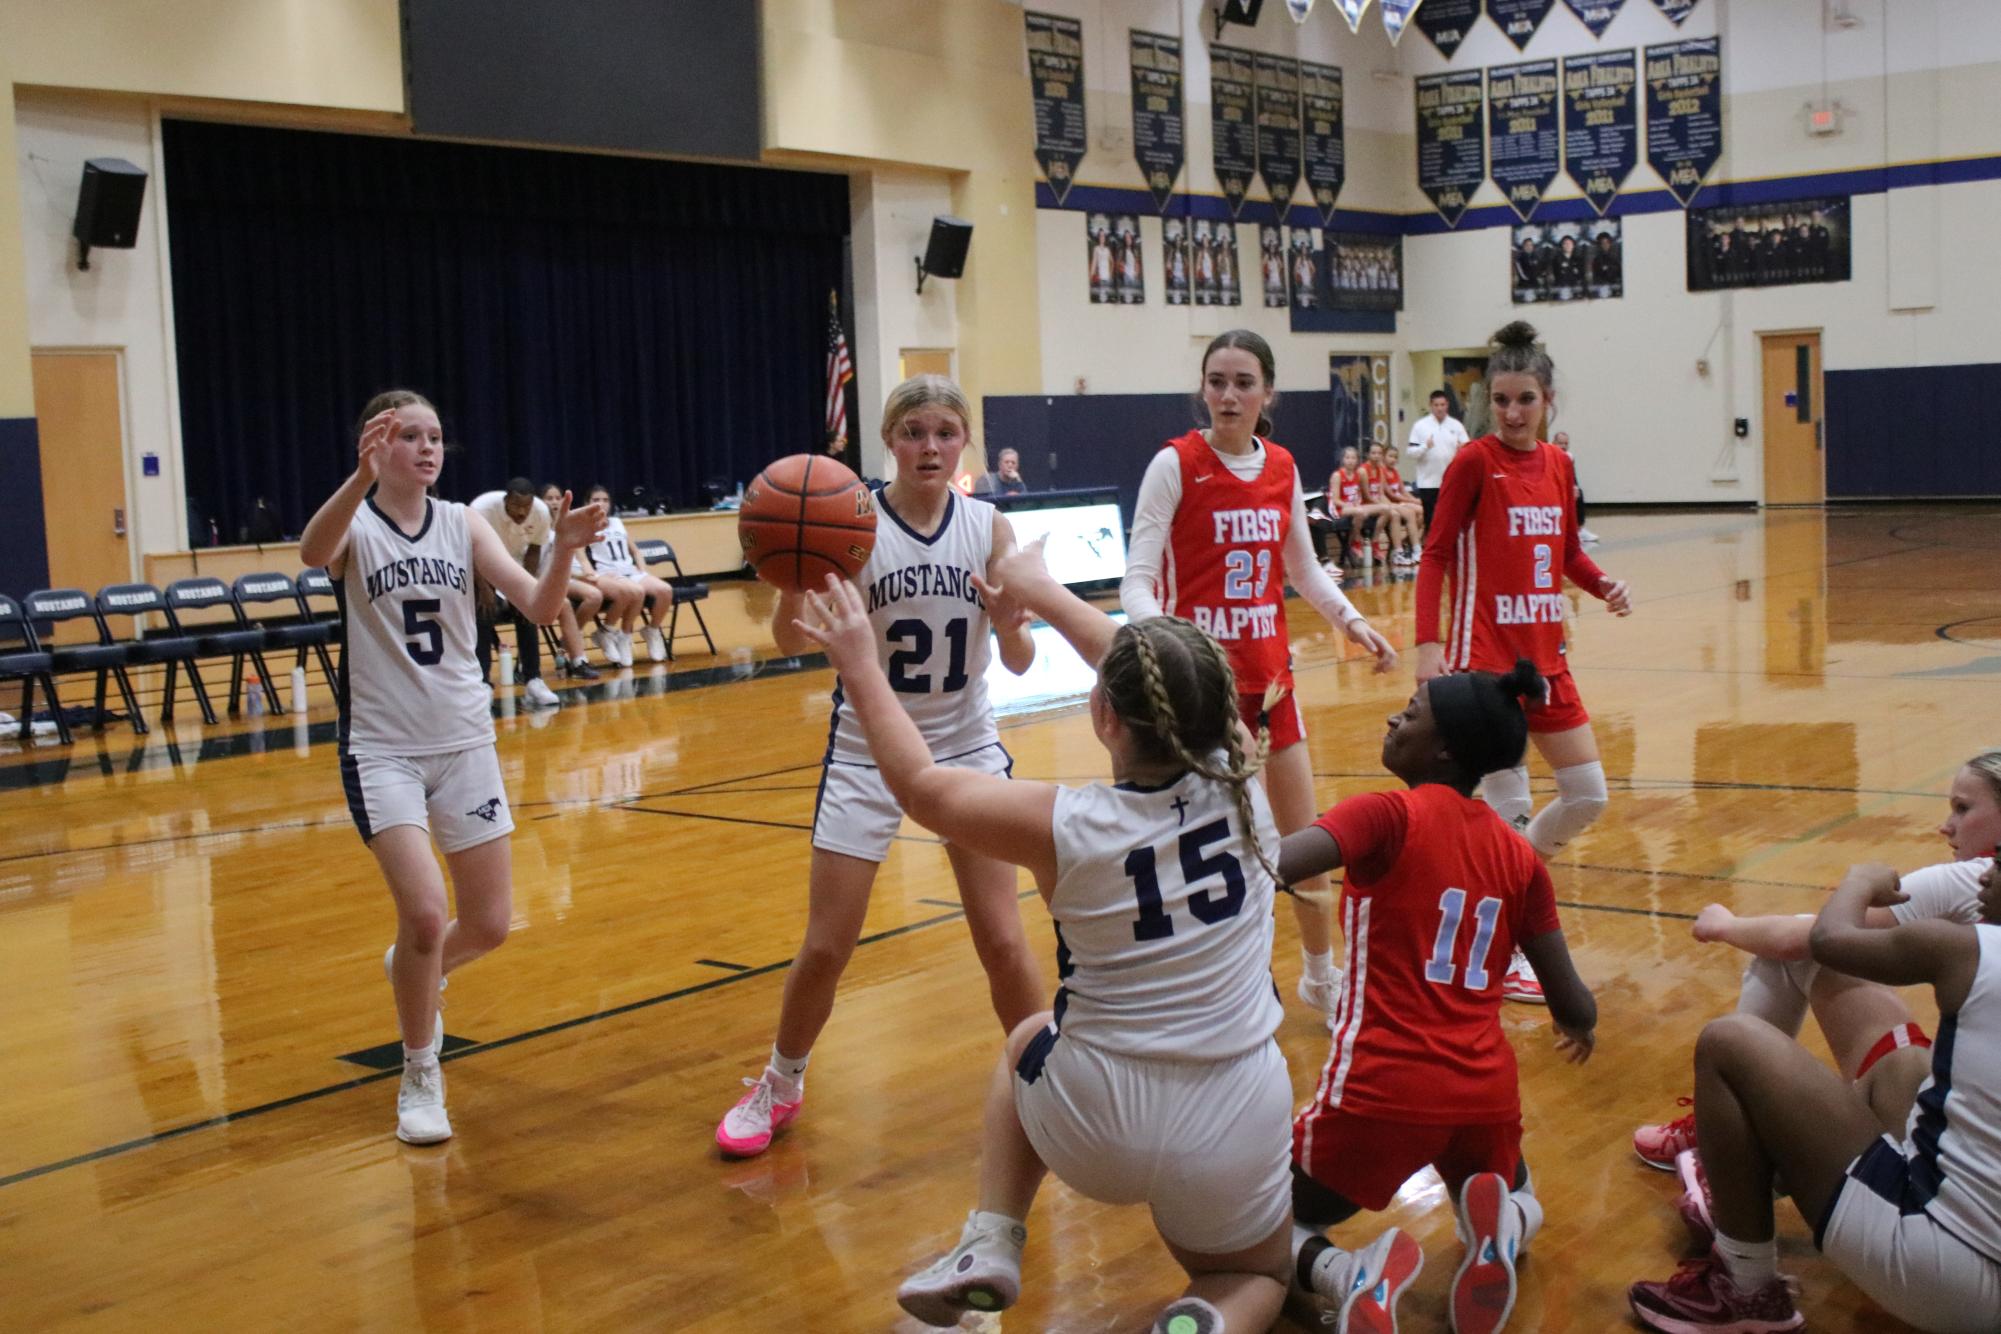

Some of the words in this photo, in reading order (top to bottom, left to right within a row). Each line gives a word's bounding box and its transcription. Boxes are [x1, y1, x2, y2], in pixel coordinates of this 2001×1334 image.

[1212, 509, 1281, 544] FIRST
[1508, 506, 1562, 536] FIRST
[607, 541, 625, 561] 11
[1534, 544, 1553, 588] 2
[367, 557, 467, 604] MUSTANGS
[1225, 549, 1271, 599] 23
[33, 597, 87, 612] MUSTANGS
[107, 591, 157, 606] MUSTANGS
[402, 599, 444, 666] 5
[886, 618, 968, 693] 21
[1125, 817, 1246, 942] 15
[1425, 887, 1503, 991] 11
